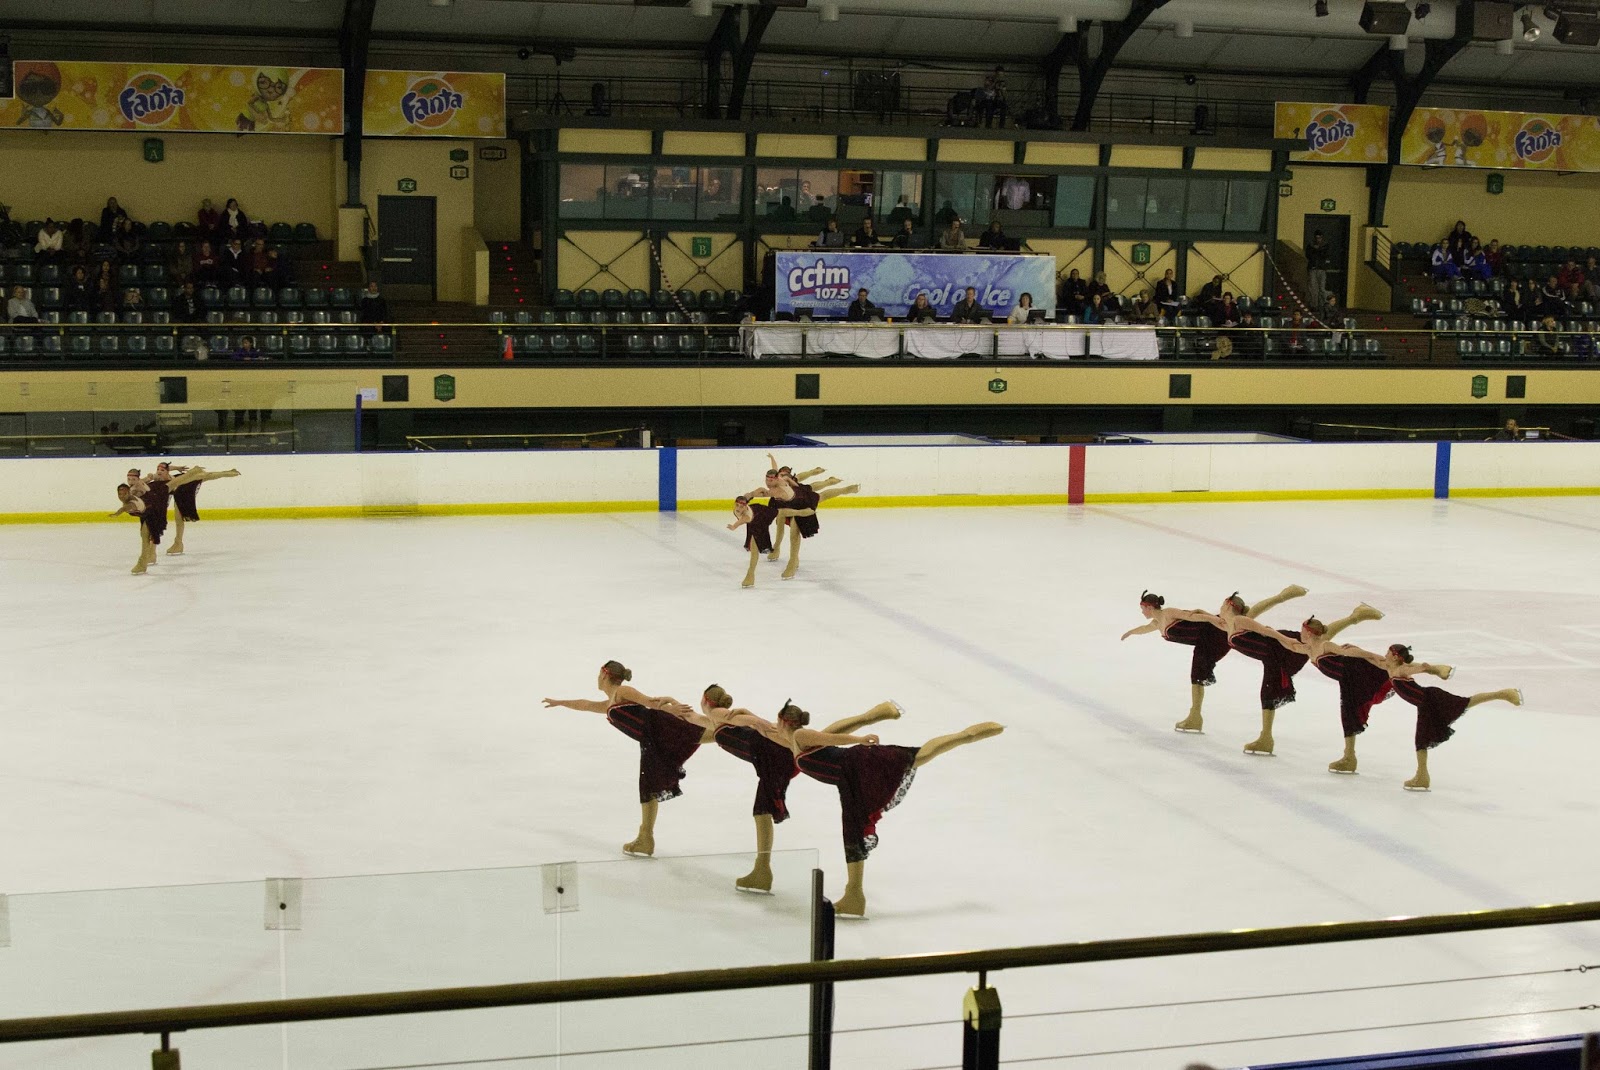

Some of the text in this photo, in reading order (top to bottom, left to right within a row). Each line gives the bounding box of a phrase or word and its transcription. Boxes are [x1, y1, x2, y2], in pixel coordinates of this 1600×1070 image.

[119, 85, 184, 121] Fanta
[402, 88, 463, 124] Fanta
[1305, 120, 1355, 151] Fanta
[1515, 129, 1561, 159] Fanta
[149, 149, 158, 159] A
[700, 244, 707, 255] B
[1139, 252, 1146, 262] B
[815, 287, 849, 300] 107.5
[981, 284, 1011, 306] Ice
